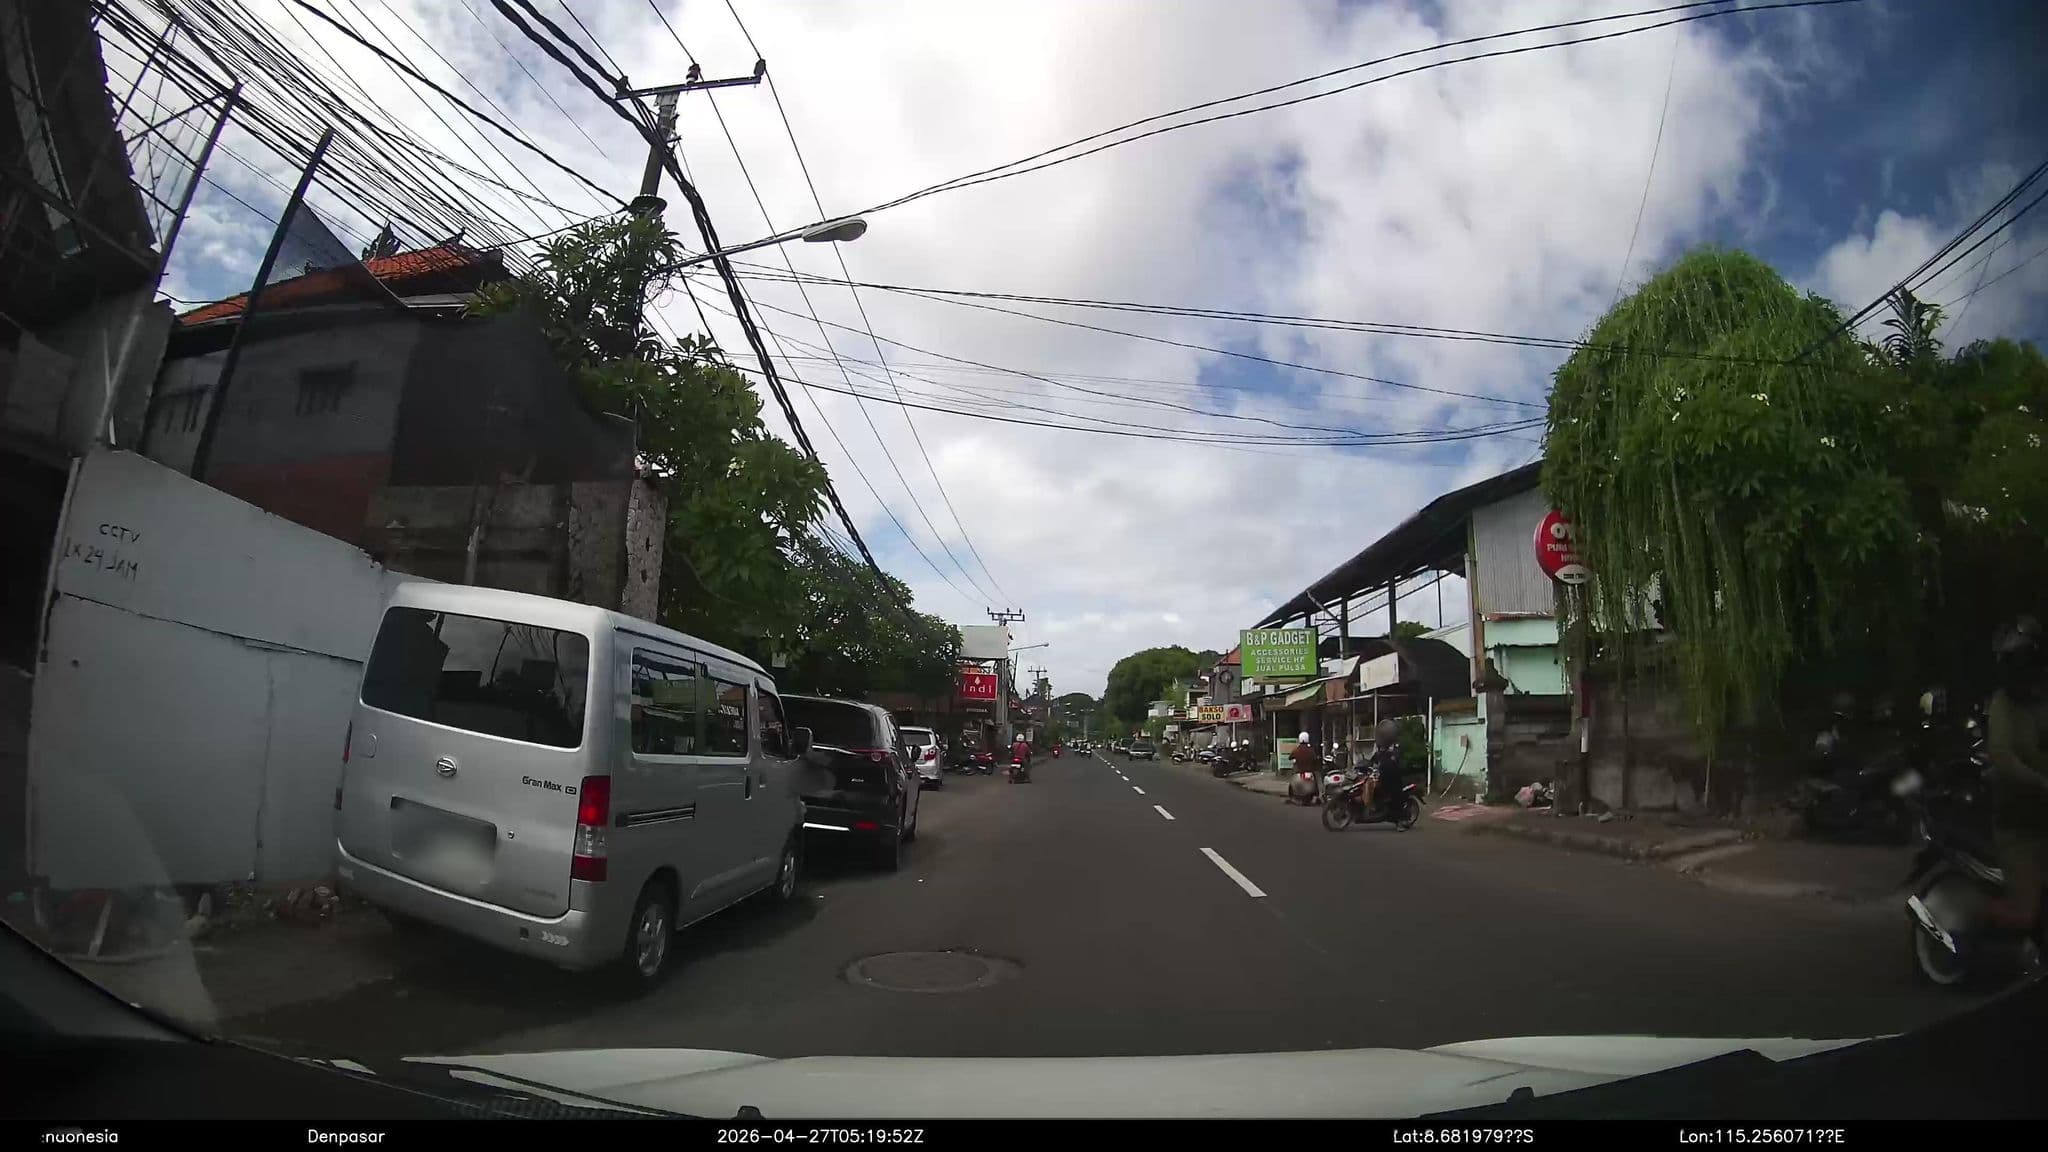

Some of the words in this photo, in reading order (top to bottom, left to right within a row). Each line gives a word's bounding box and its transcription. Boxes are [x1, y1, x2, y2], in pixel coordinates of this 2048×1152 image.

[99, 524, 141, 542] CCTV
[1246, 631, 1267, 646] B&P
[1270, 630, 1311, 646] GADGET
[1250, 647, 1309, 656] ACCESSORIES
[1255, 656, 1292, 664] SERVICE
[1294, 656, 1305, 664] HP
[1255, 664, 1276, 672] JUAL
[1278, 664, 1306, 672] PULSA
[1198, 705, 1224, 714] BAKSO
[1201, 713, 1221, 721] SOLO
[522, 776, 542, 788] Gran
[543, 780, 562, 792] Max
